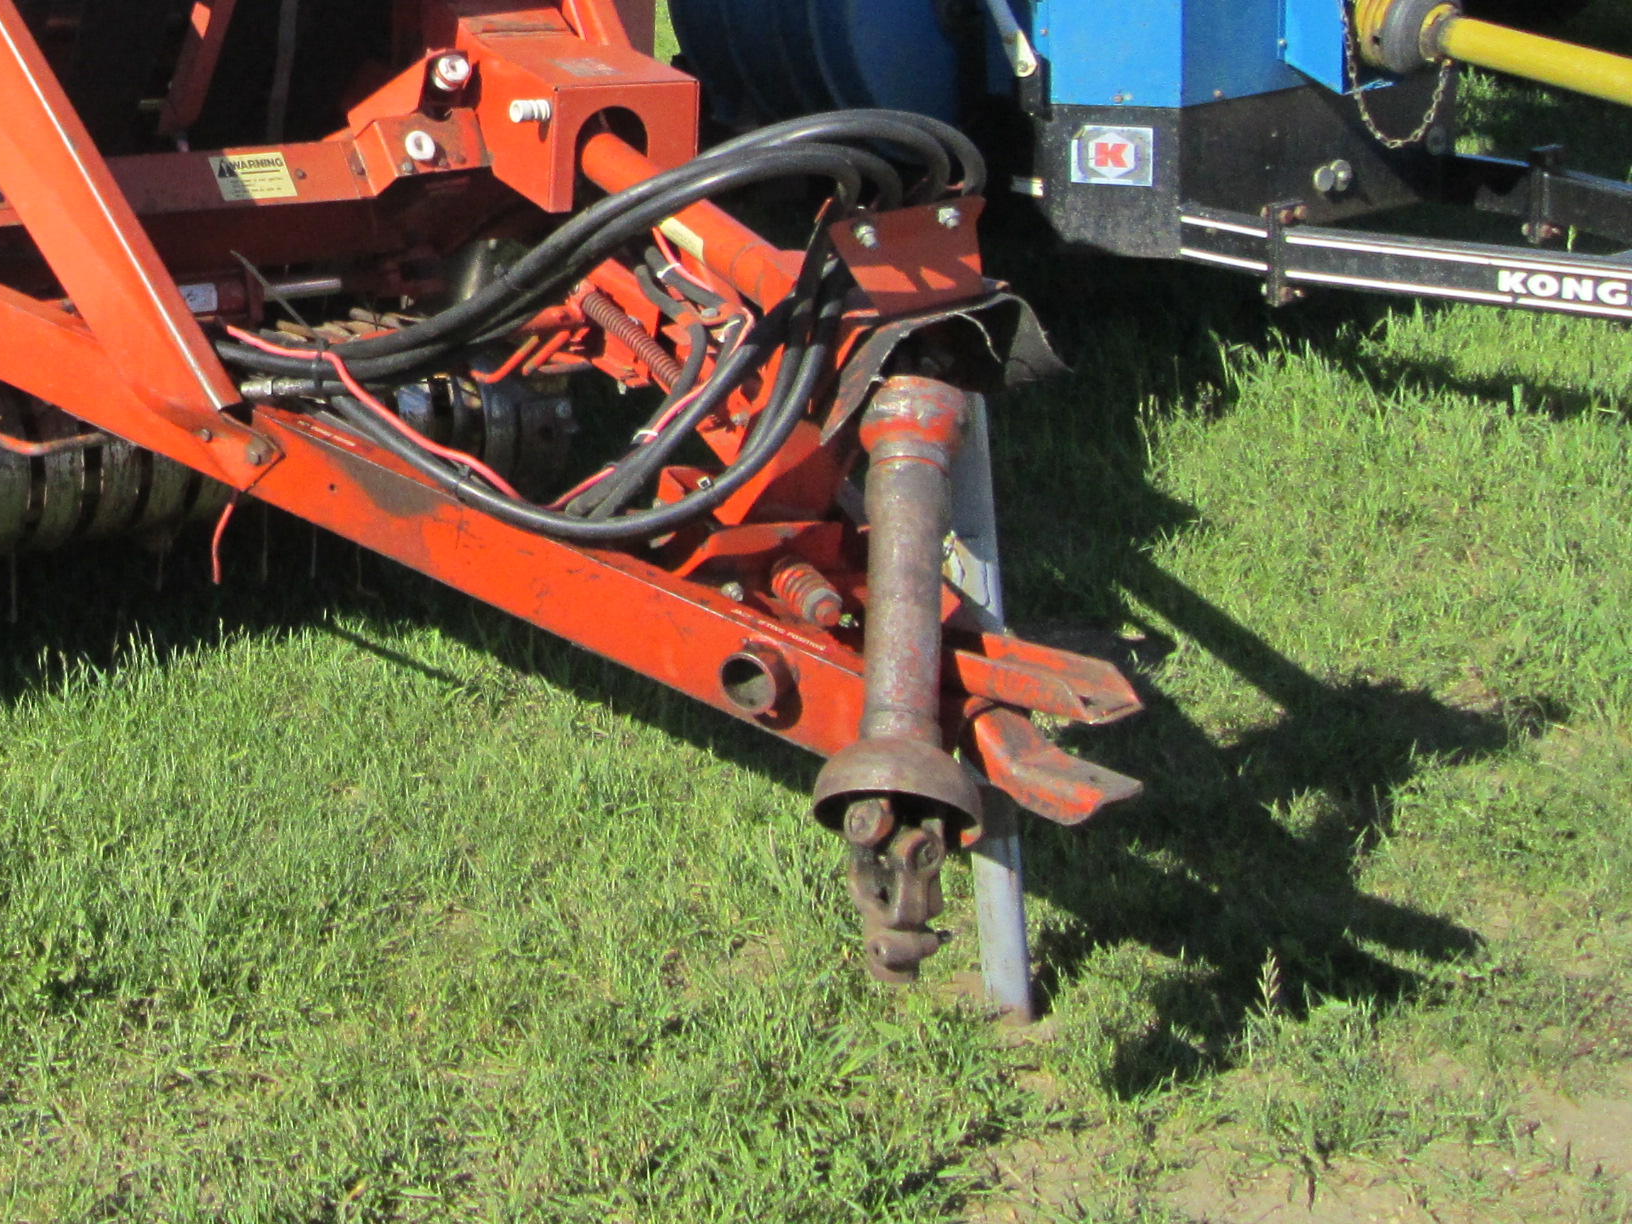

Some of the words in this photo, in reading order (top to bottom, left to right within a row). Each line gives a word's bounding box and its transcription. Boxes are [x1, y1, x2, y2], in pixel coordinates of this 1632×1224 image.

[228, 158, 283, 170] WARNING
[1095, 142, 1128, 168] K
[1498, 270, 1632, 305] KONG
